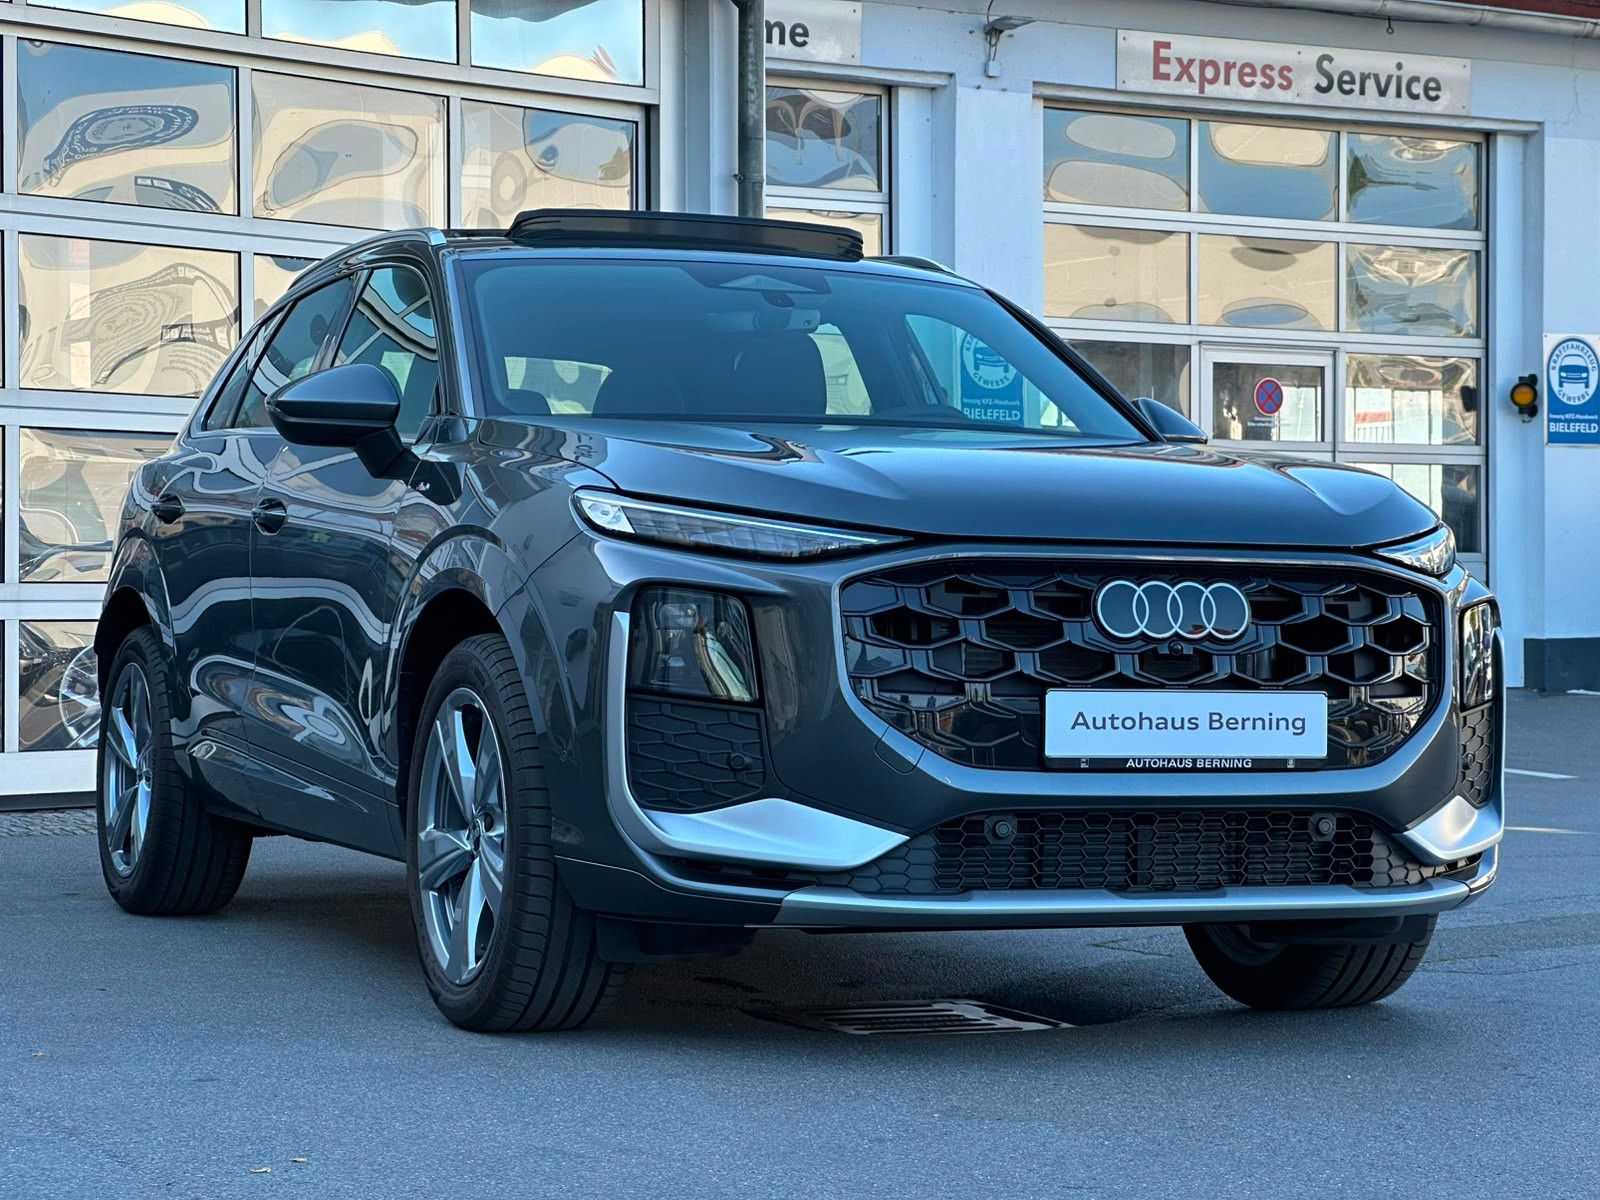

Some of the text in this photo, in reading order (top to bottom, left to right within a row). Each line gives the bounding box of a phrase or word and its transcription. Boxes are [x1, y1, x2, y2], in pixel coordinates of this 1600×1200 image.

[1152, 40, 1442, 101] Express Service
[1551, 343, 1597, 372] KRAFTFAHRZEUG
[973, 372, 1010, 387] GEWERBE
[1557, 389, 1590, 404] GEWERBE
[1549, 422, 1599, 434] BIELEFELD
[1070, 711, 1306, 736] Autohaus Berning
[1126, 758, 1252, 768] AUTOHAUS BERNING
